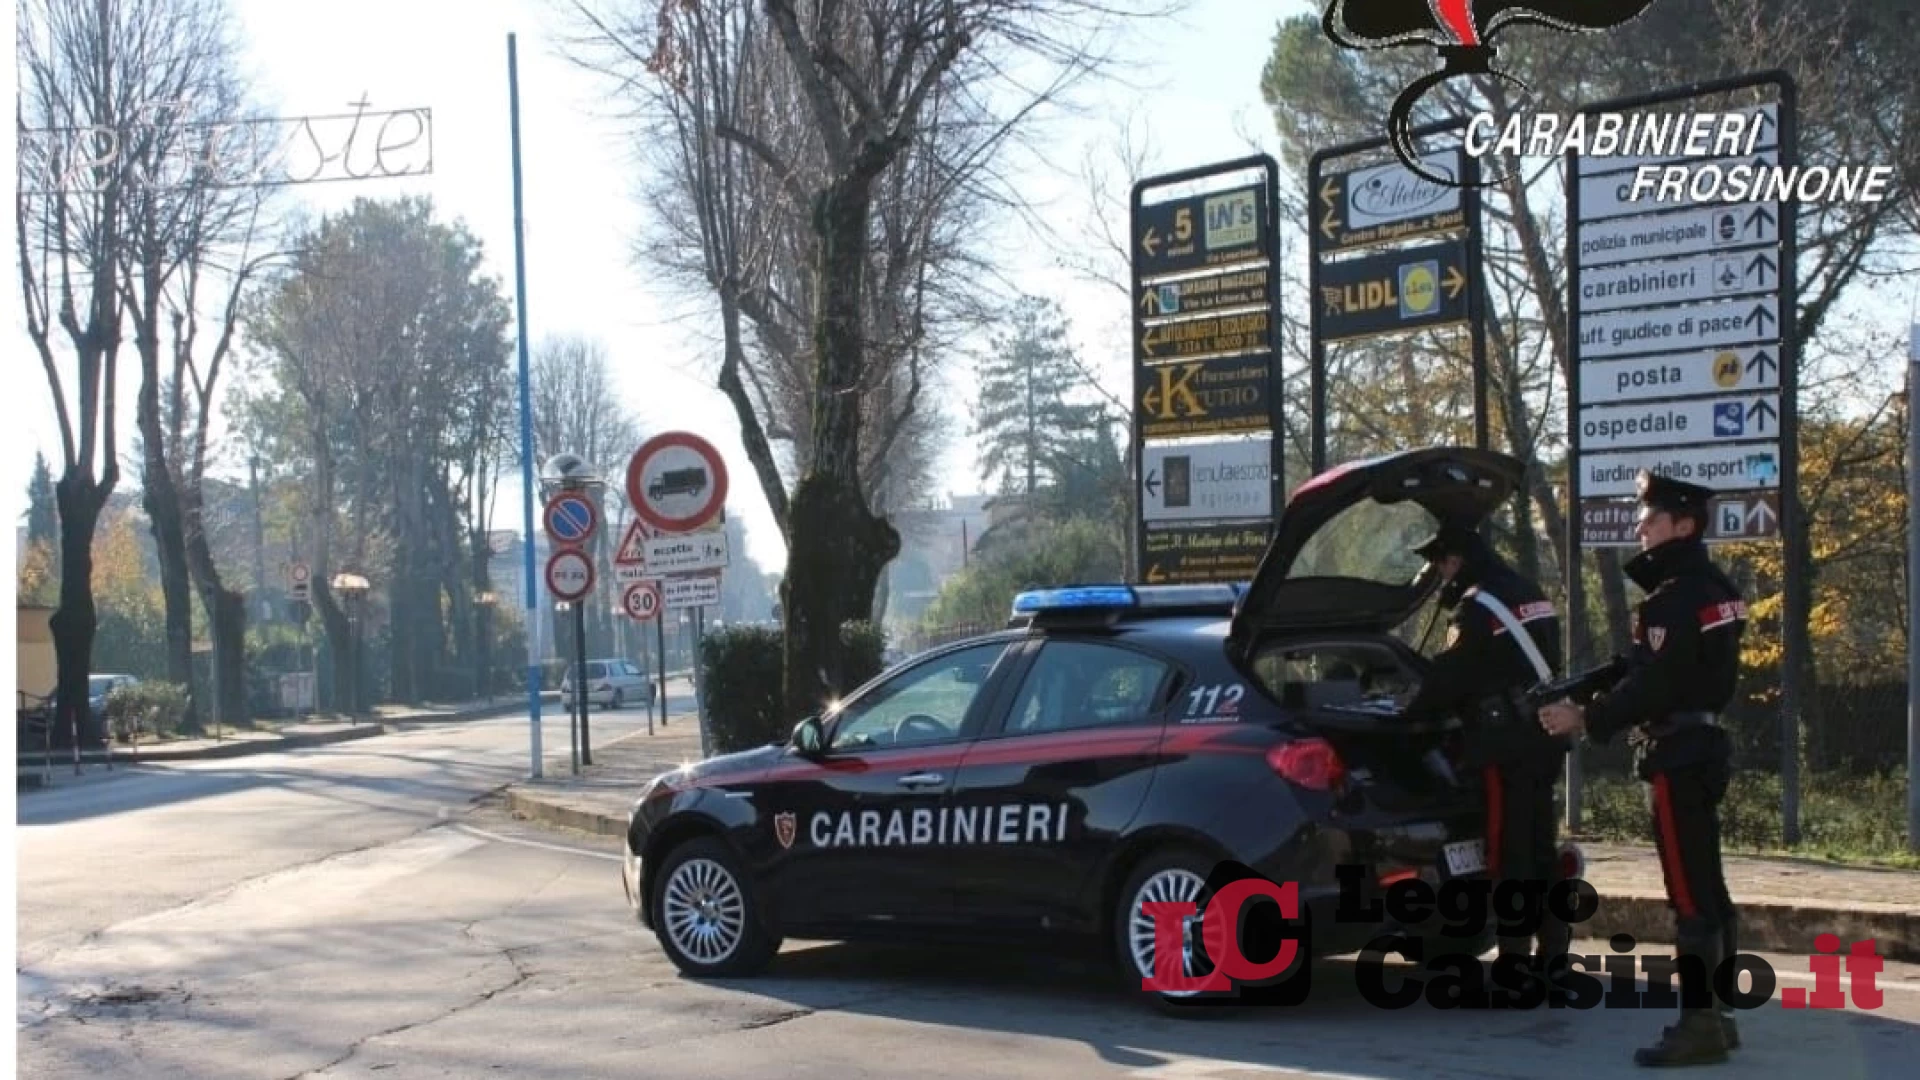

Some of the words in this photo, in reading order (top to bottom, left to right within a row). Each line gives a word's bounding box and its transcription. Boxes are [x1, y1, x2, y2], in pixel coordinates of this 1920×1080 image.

[1175, 207, 1192, 240] 5
[1581, 231, 1627, 253] polizia
[1629, 223, 1708, 248] municipale
[1344, 279, 1398, 312] LIDL
[1582, 267, 1696, 298] carabinieri
[1612, 320, 1672, 346] giudice
[1678, 317, 1693, 335] di
[1699, 315, 1743, 334] pace
[1155, 363, 1208, 418] K
[1617, 365, 1682, 393] posta
[1583, 411, 1688, 440] ospedale
[632, 592, 653, 611] 30
[1187, 684, 1244, 715] 112
[810, 803, 1069, 848] CARABINIERI
